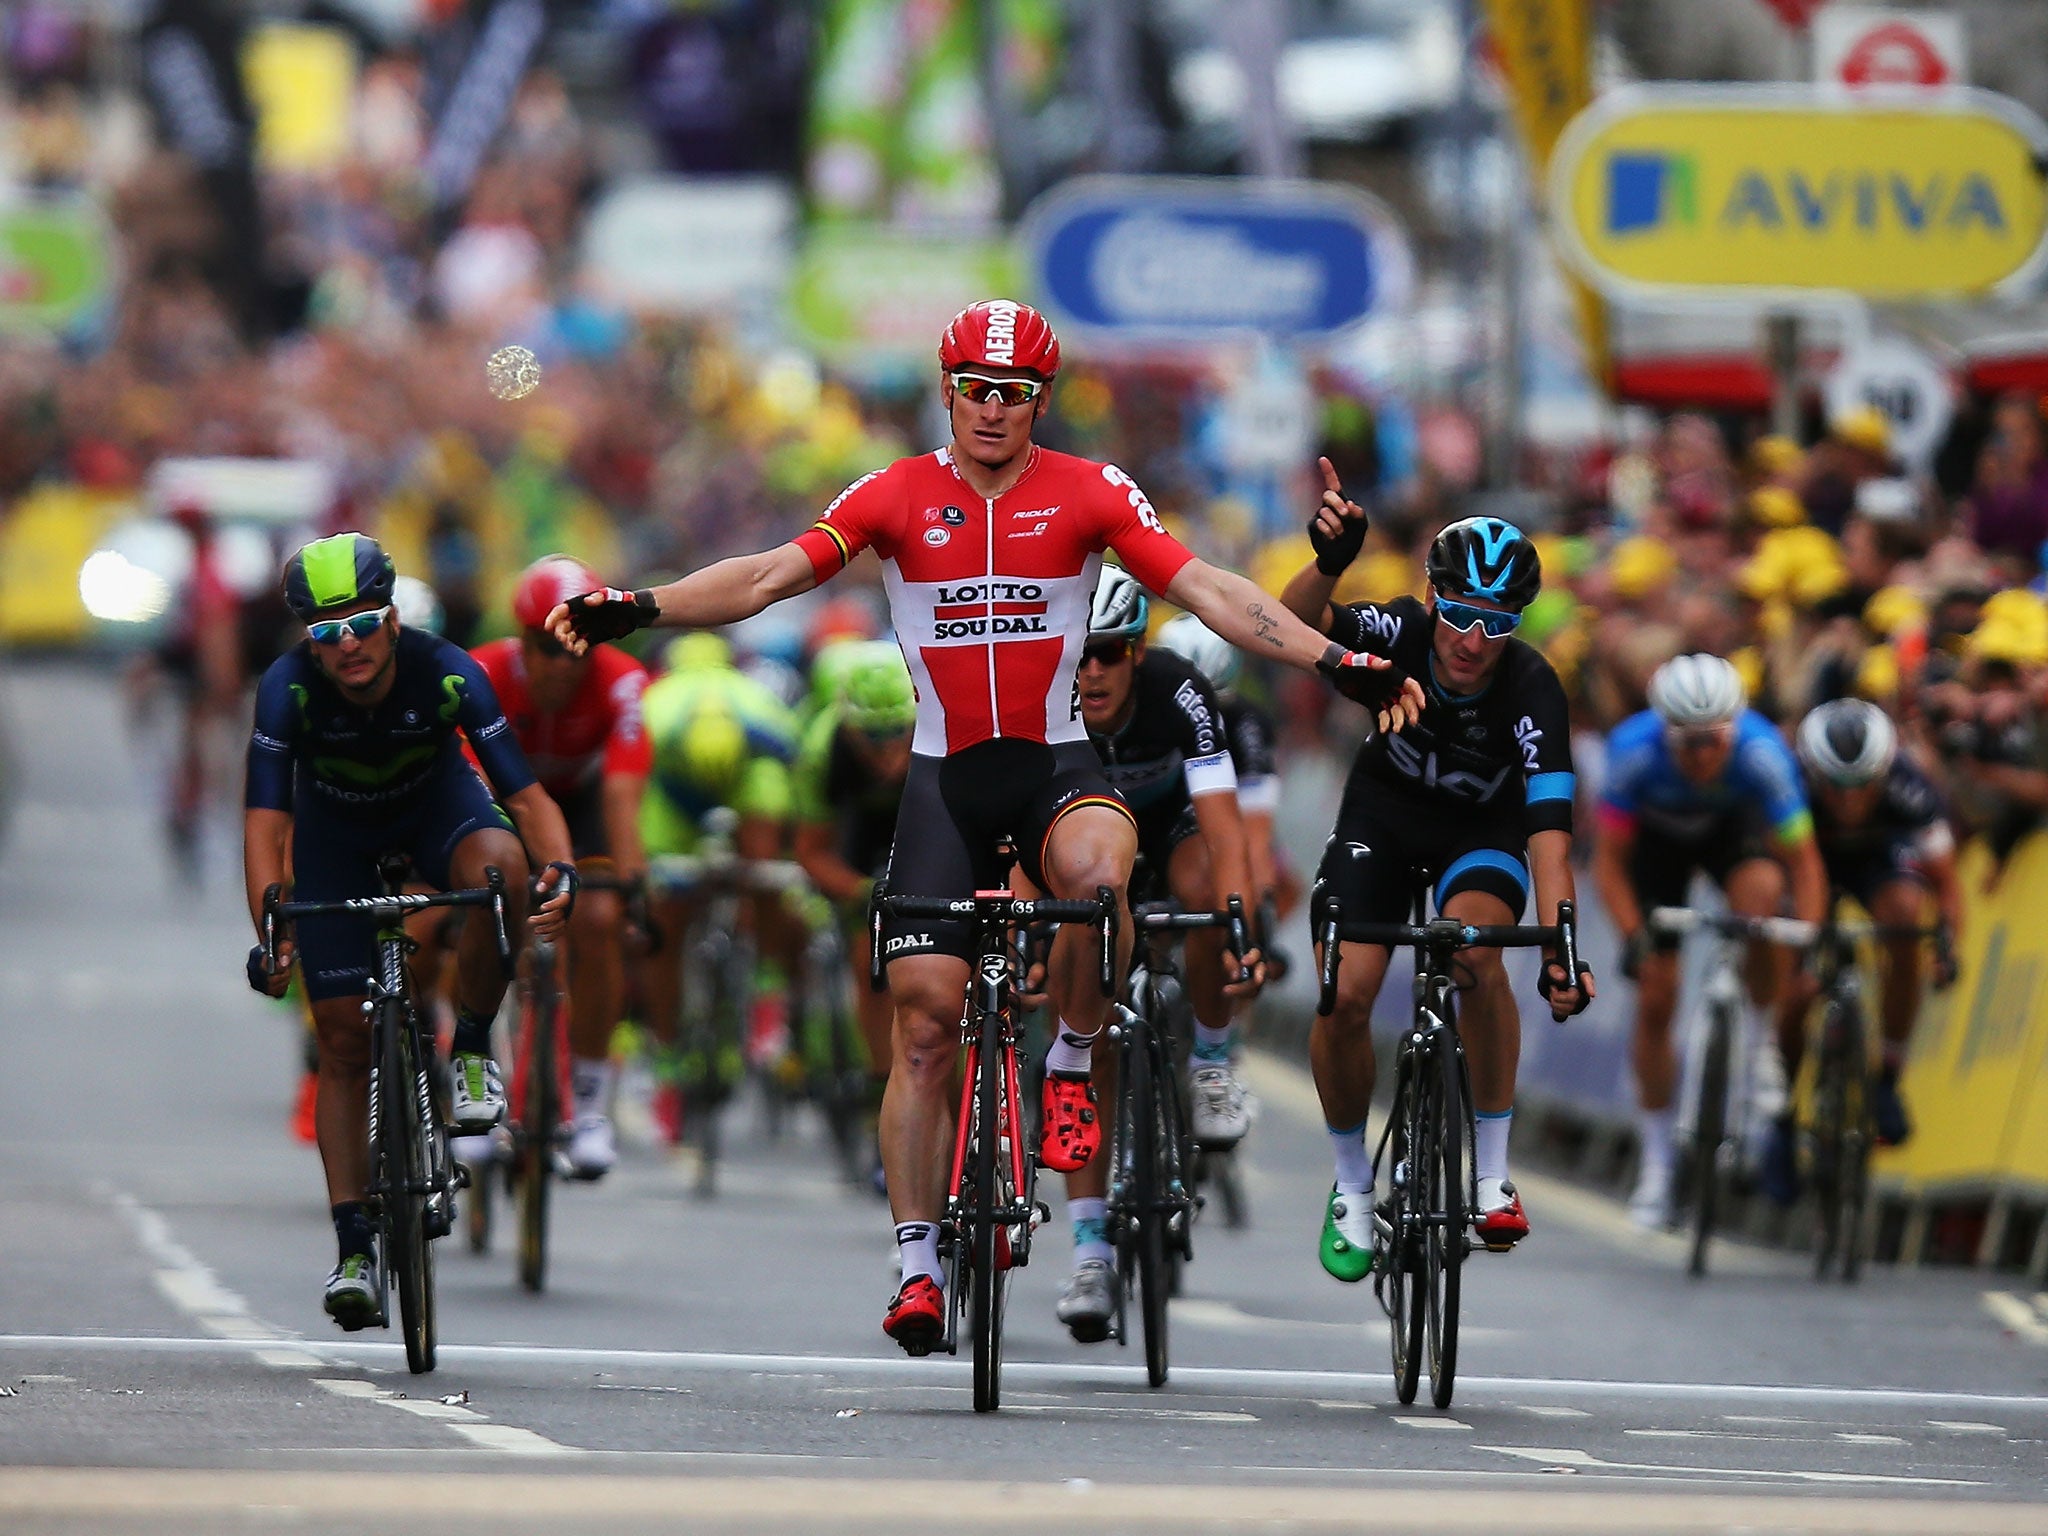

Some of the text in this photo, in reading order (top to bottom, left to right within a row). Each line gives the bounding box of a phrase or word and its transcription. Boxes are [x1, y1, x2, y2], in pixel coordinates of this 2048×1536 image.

[1720, 168, 2009, 234] AVIVA
[1012, 506, 1060, 519] RIDLEY
[938, 583, 1042, 603] LOTTO
[934, 617, 1047, 640] SOUDAL
[1174, 678, 1215, 752] latexco
[345, 894, 430, 907] CANYON
